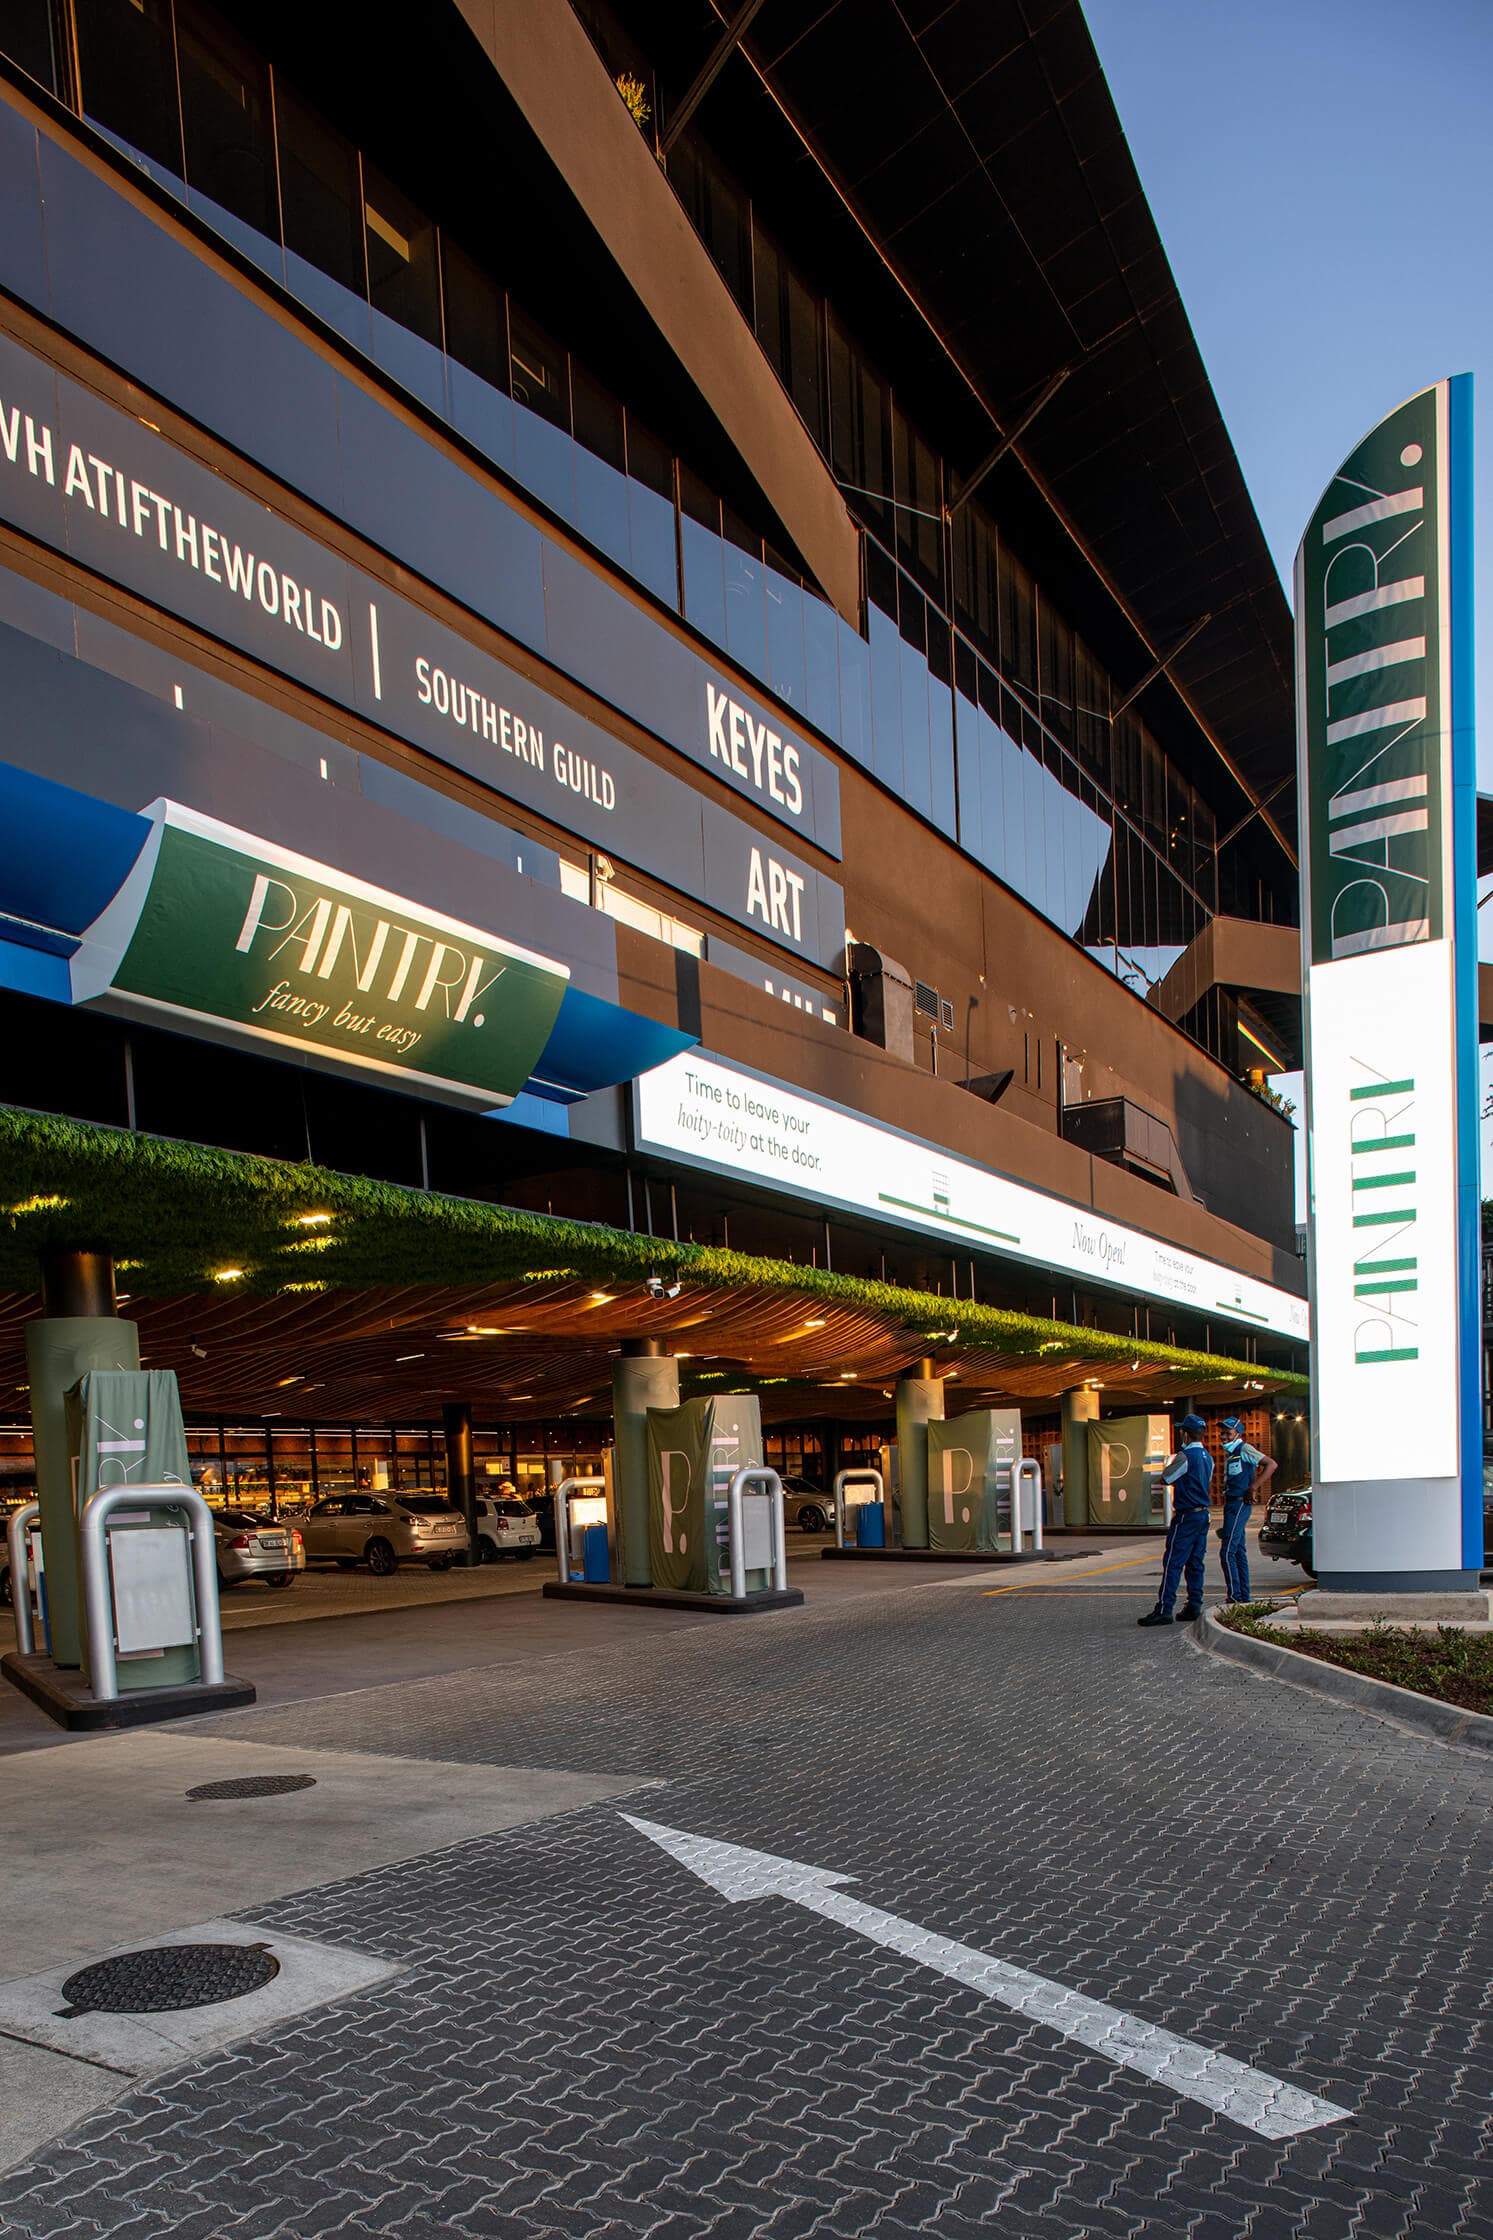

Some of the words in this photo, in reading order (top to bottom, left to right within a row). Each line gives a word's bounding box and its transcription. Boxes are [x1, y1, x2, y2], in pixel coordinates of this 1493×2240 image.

[416, 658, 545, 771] SOUTHERN
[553, 743, 616, 811] GUILD
[706, 682, 804, 815] KEYES
[1323, 443, 1430, 960] PANTRY.
[235, 874, 506, 1028] PANTRY.
[747, 847, 805, 942] ART
[252, 981, 330, 1027] fancy
[333, 1001, 376, 1034] but
[376, 1024, 422, 1054] easy
[677, 1103, 747, 1152] hoity-toity
[750, 1134, 764, 1153] at
[767, 1137, 788, 1160] the
[792, 1145, 822, 1171] door.
[685, 1072, 722, 1103] Time
[726, 1088, 740, 1110] to
[744, 1093, 779, 1124] leave
[782, 1113, 810, 1134] your
[1073, 1222, 1096, 1255] Now
[1098, 1232, 1126, 1270] Open!
[1349, 1056, 1418, 1364] PANTRY
